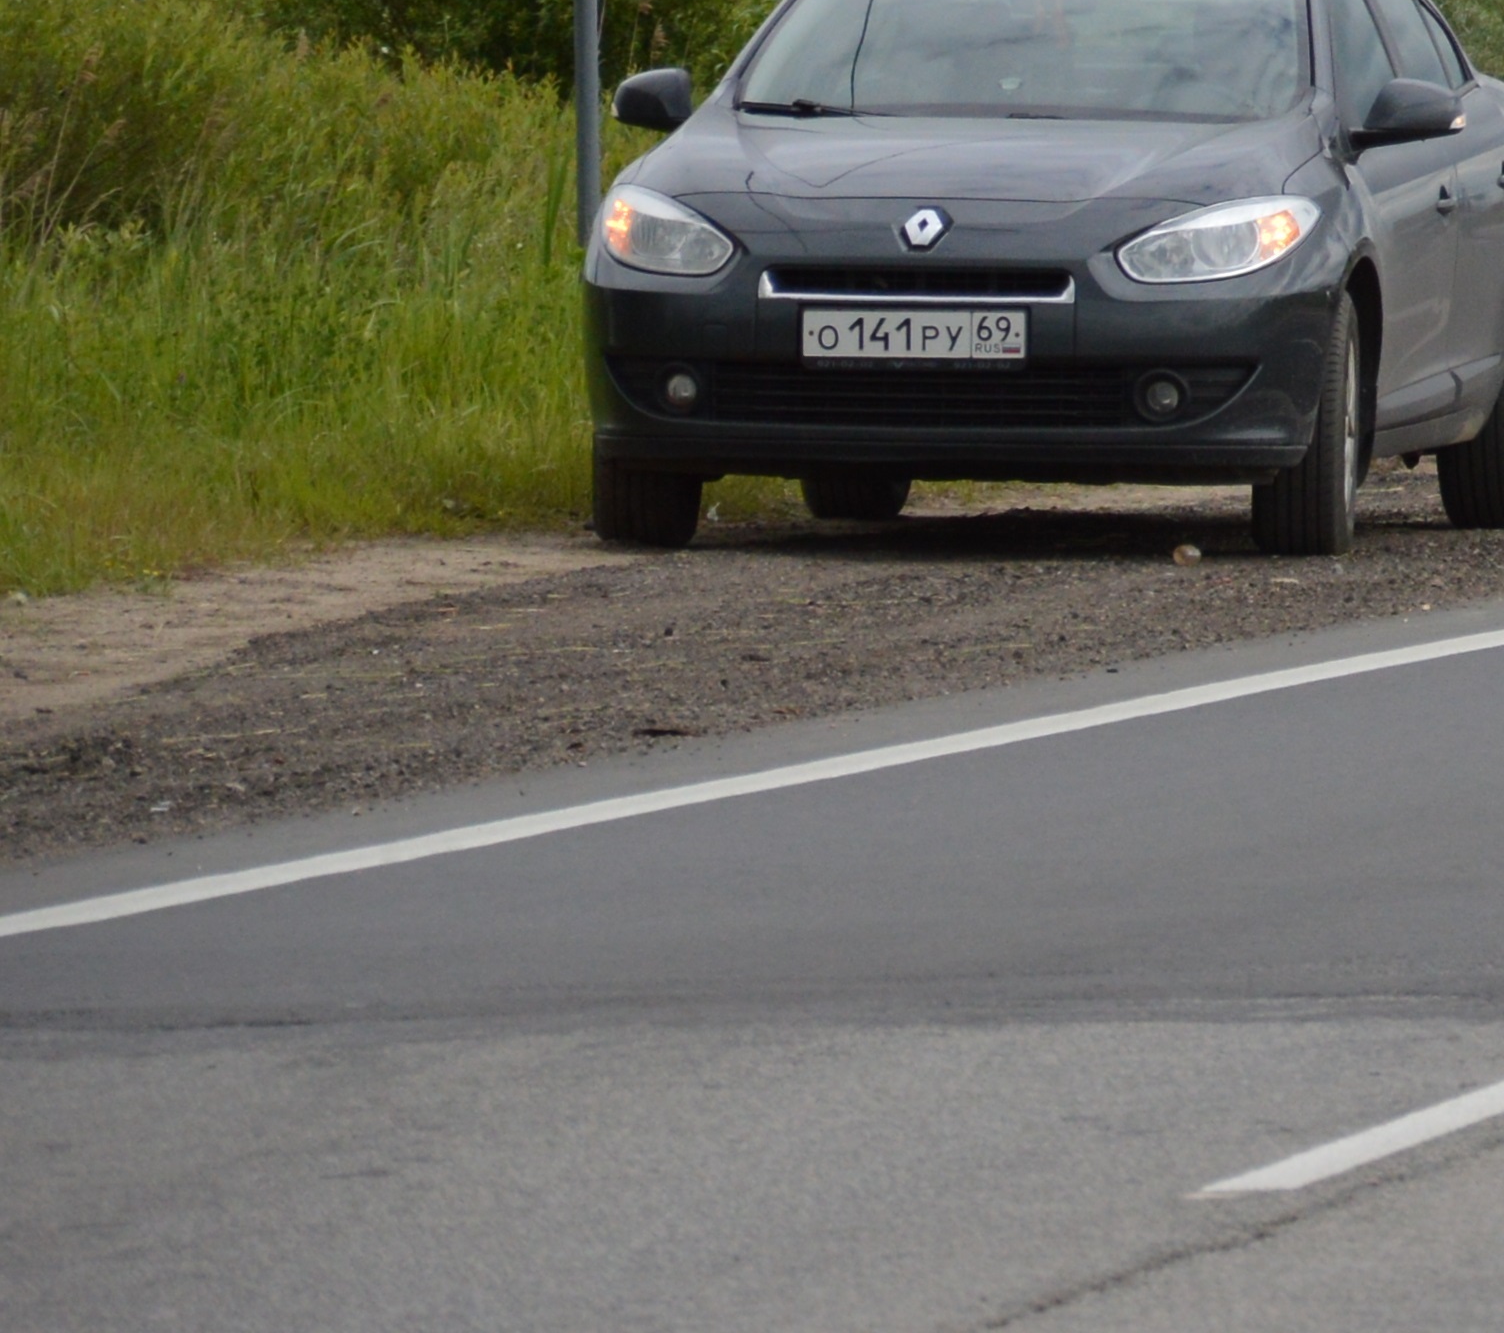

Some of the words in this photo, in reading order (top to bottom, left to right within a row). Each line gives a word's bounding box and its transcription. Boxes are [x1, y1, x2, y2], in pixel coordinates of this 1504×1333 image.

[817, 317, 963, 351] О141РУ
[976, 316, 1012, 342] 69
[974, 343, 1000, 353] RUS
